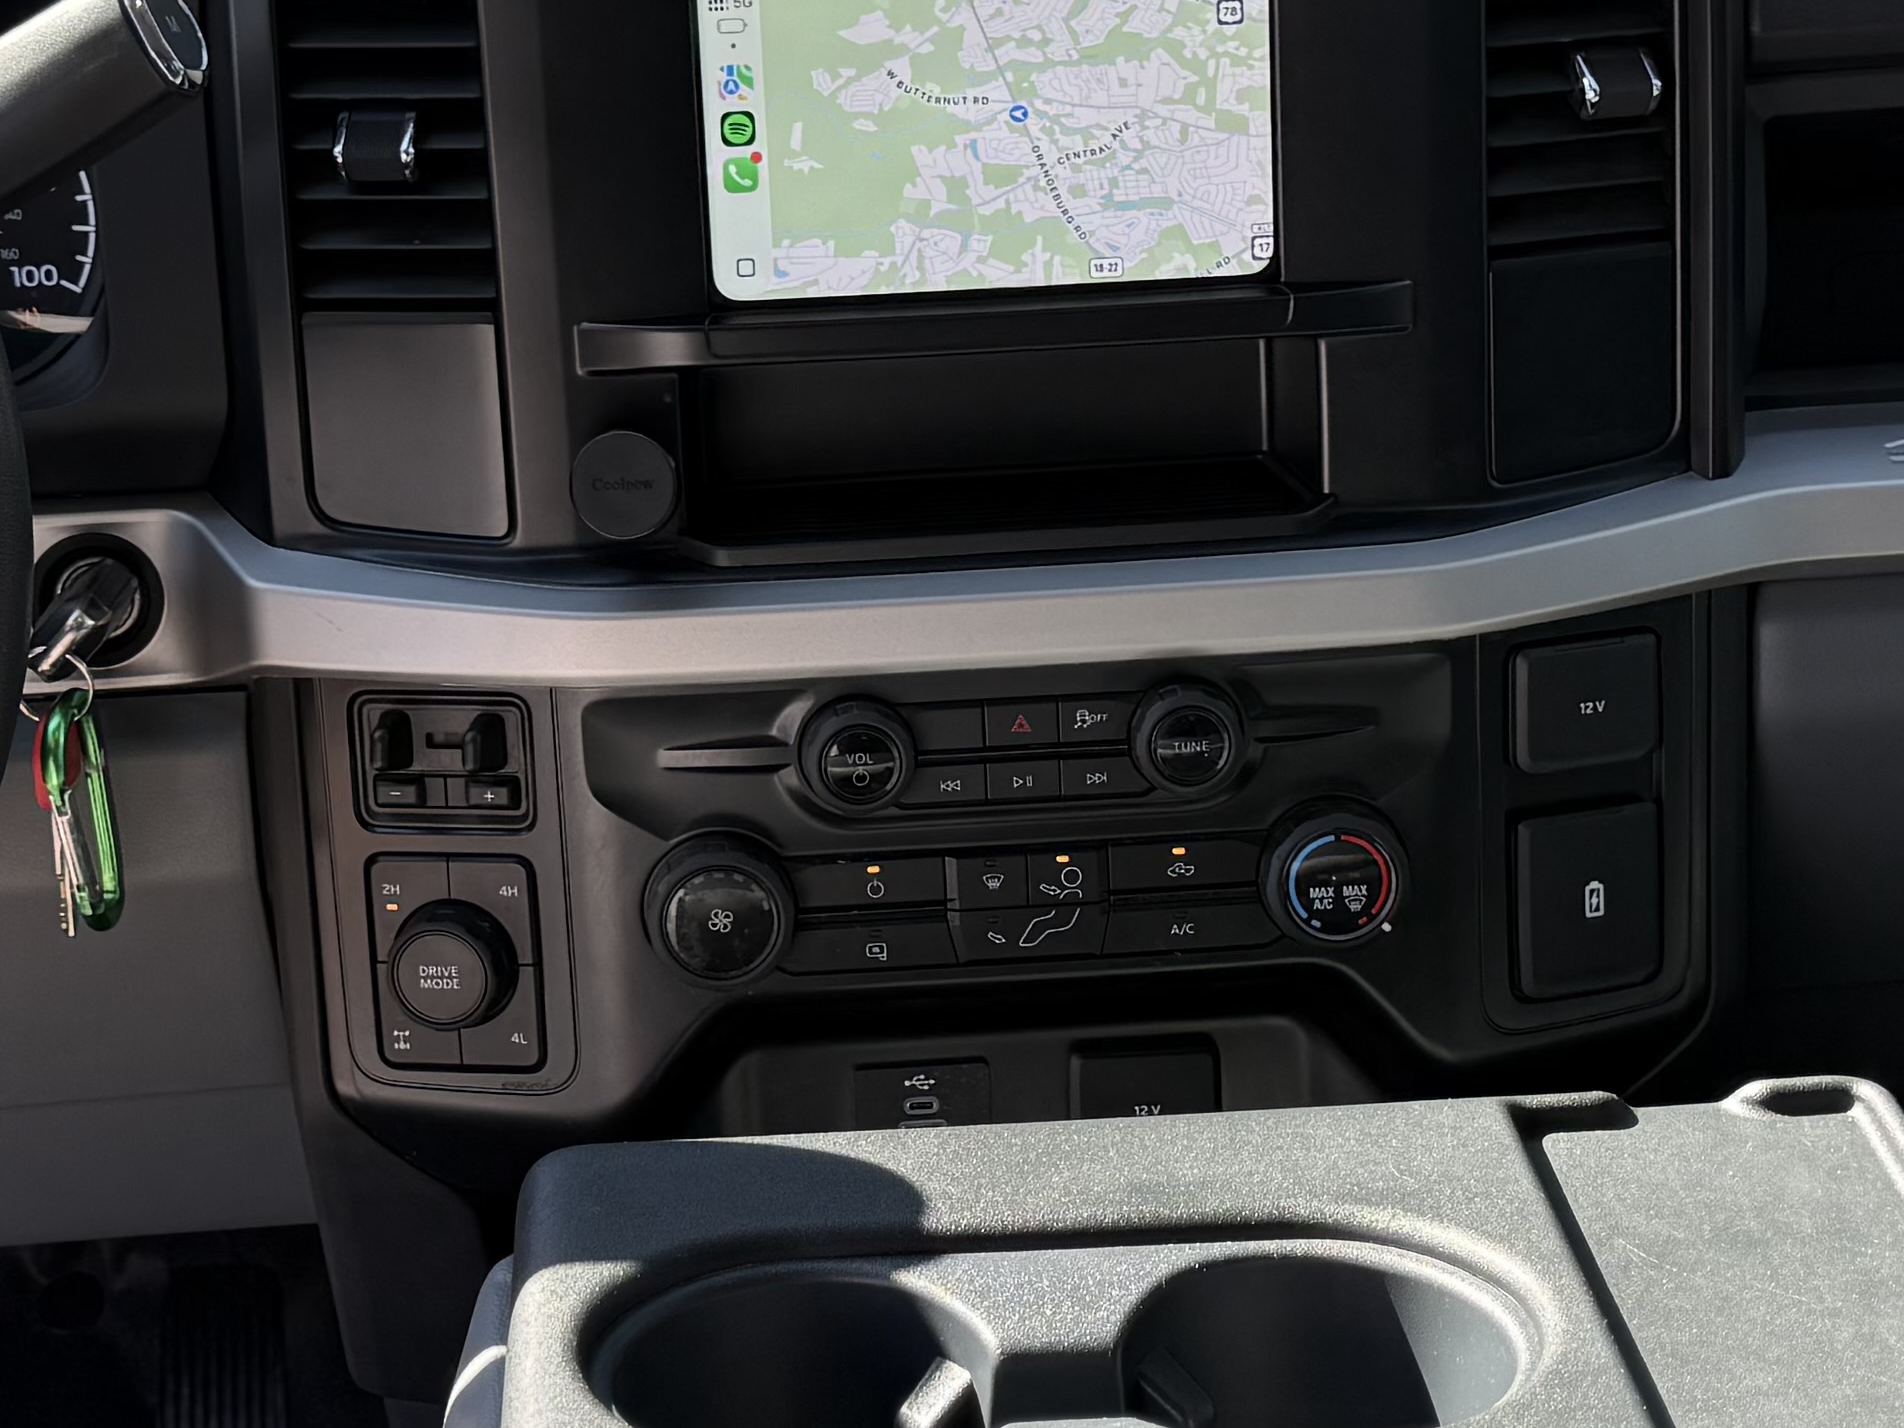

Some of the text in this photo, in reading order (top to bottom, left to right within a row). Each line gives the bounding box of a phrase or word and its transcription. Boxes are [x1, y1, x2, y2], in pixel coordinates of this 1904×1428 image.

[896, 80, 968, 106] BUTTERNUT
[972, 96, 990, 106] RD
[1057, 120, 1132, 166] CENTRAL AVE
[1258, 242, 1271, 253] 17
[8, 264, 59, 288] 100
[1171, 739, 1211, 754] TUNE
[845, 751, 874, 766] VOL
[381, 883, 401, 897] 2H
[498, 885, 519, 898] 4H
[1308, 885, 1335, 900] MAX
[1342, 883, 1369, 898] MAX
[1312, 898, 1334, 912] A/C
[1170, 922, 1196, 937] A/C
[418, 965, 460, 978] DRIVE
[419, 977, 462, 991] MODE
[510, 1032, 529, 1045] 4L
